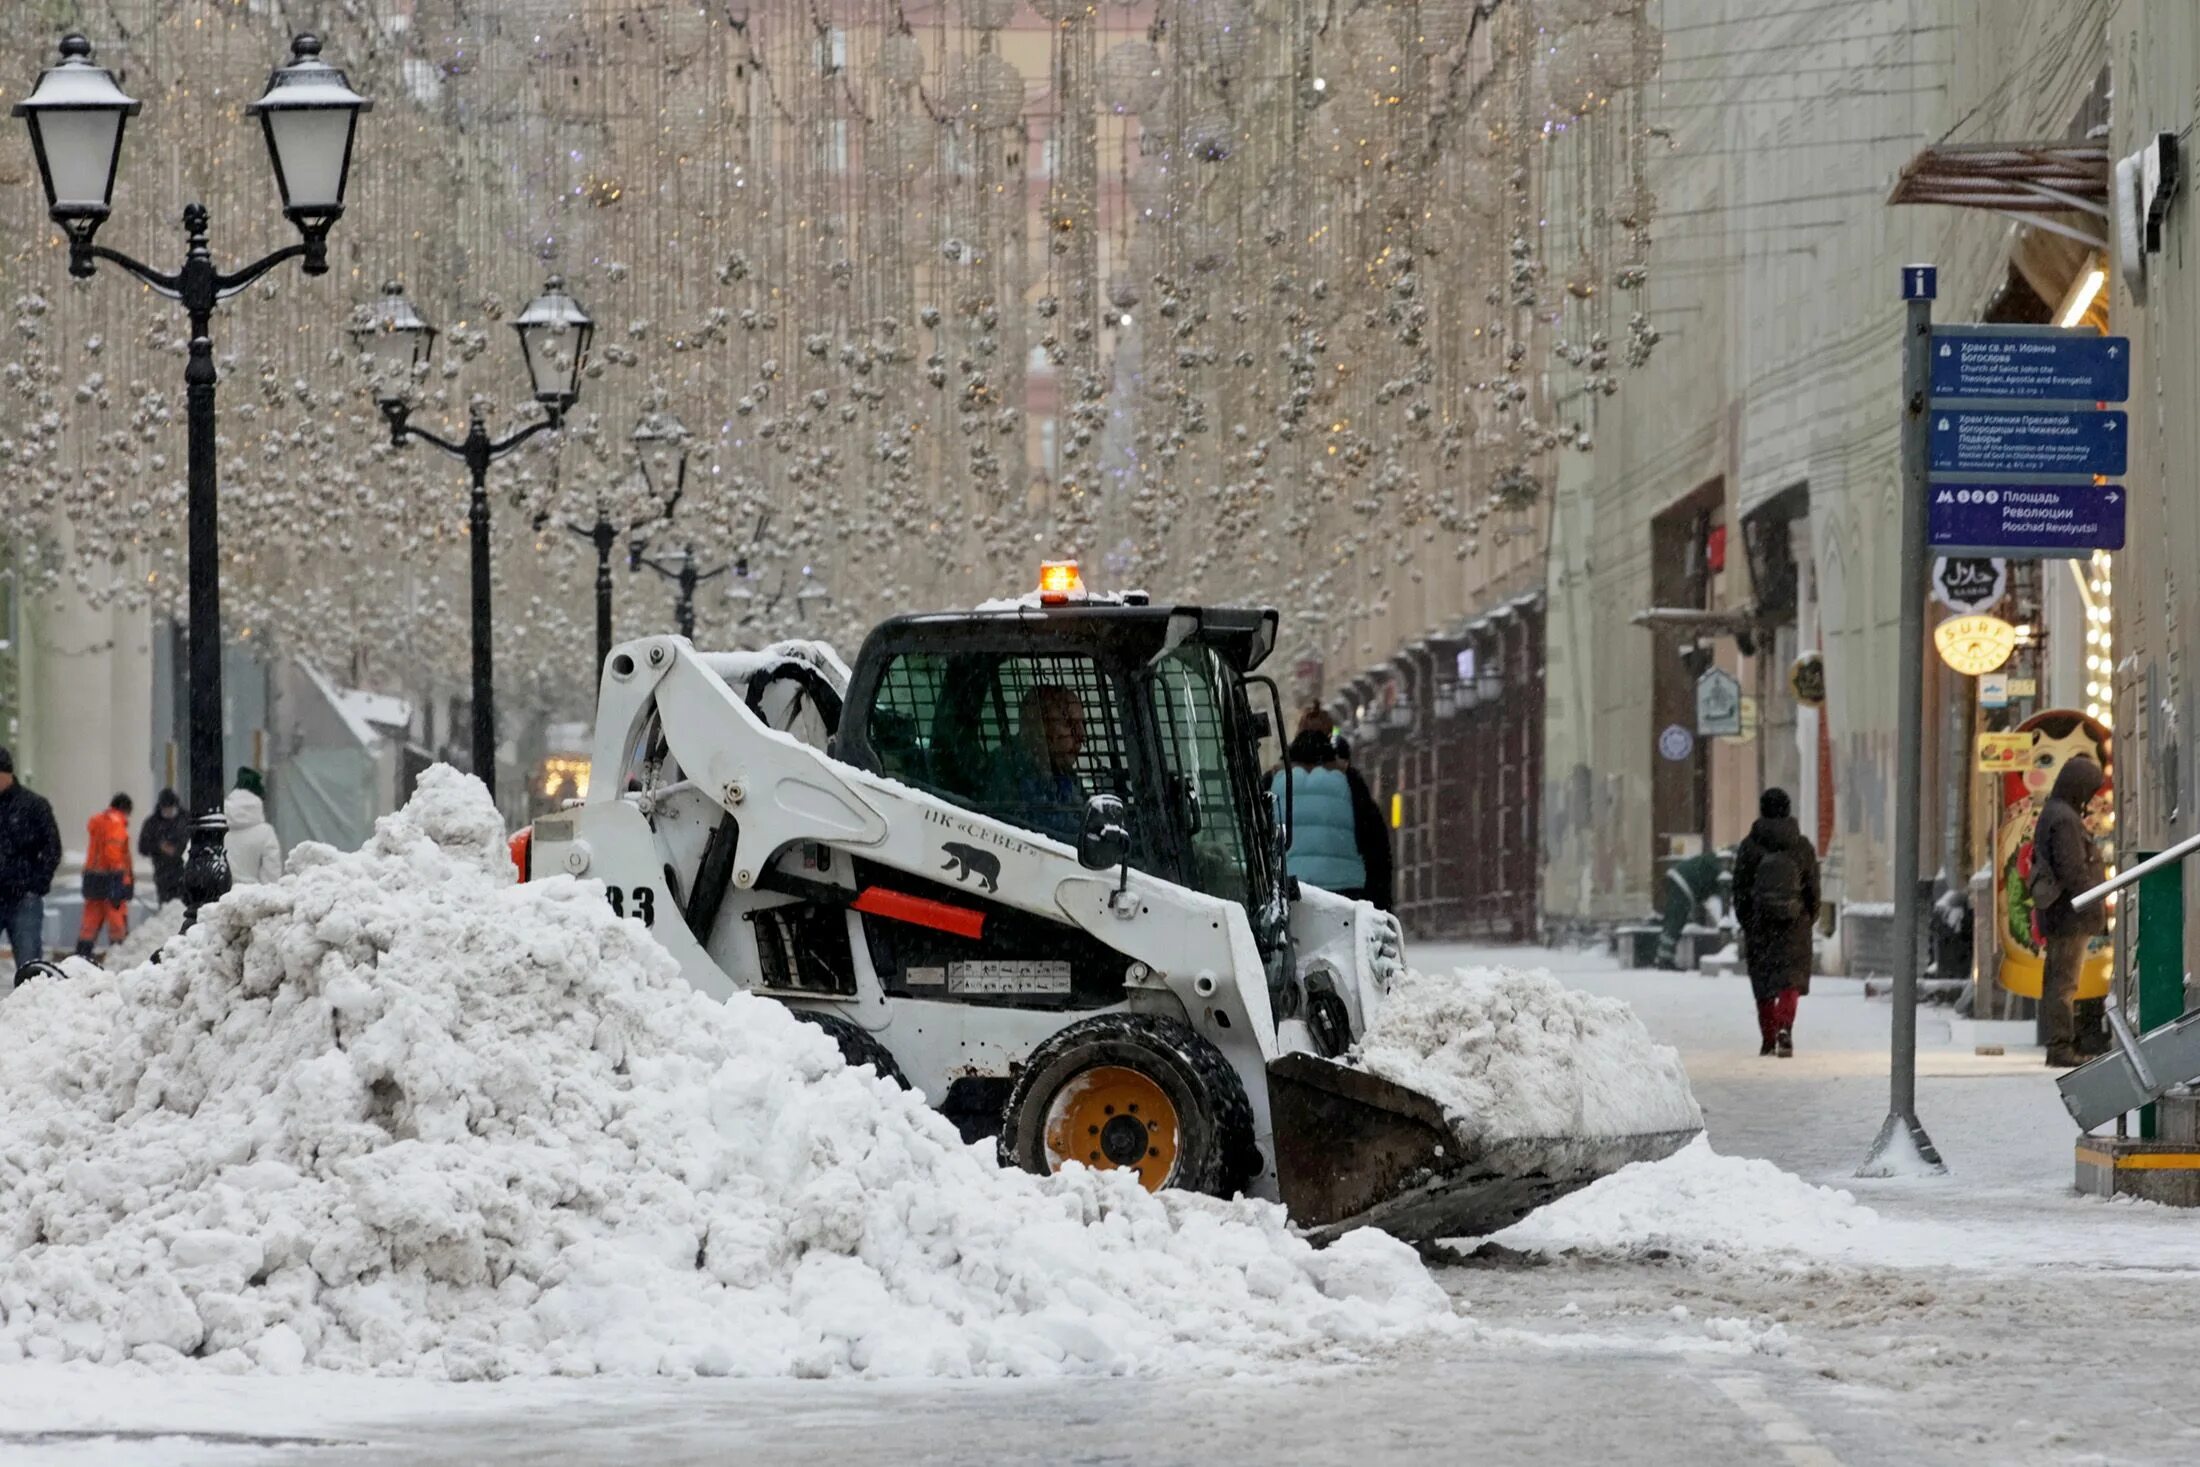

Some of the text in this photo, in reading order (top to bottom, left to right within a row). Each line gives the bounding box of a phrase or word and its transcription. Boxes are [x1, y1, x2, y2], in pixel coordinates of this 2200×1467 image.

[1961, 343, 1987, 353] Храм
[1961, 354, 2011, 363] Богослова
[1961, 364, 1988, 373] Church
[1989, 364, 1998, 373] of
[2036, 376, 2051, 385] and
[2053, 376, 2092, 387] Evangelist
[1960, 415, 1982, 425] Храм
[2003, 491, 2060, 504] Площадь
[2003, 506, 2074, 519] Революции
[2002, 521, 2097, 534] Ploschad Revolyutsii
[1944, 621, 2005, 640] SURF
